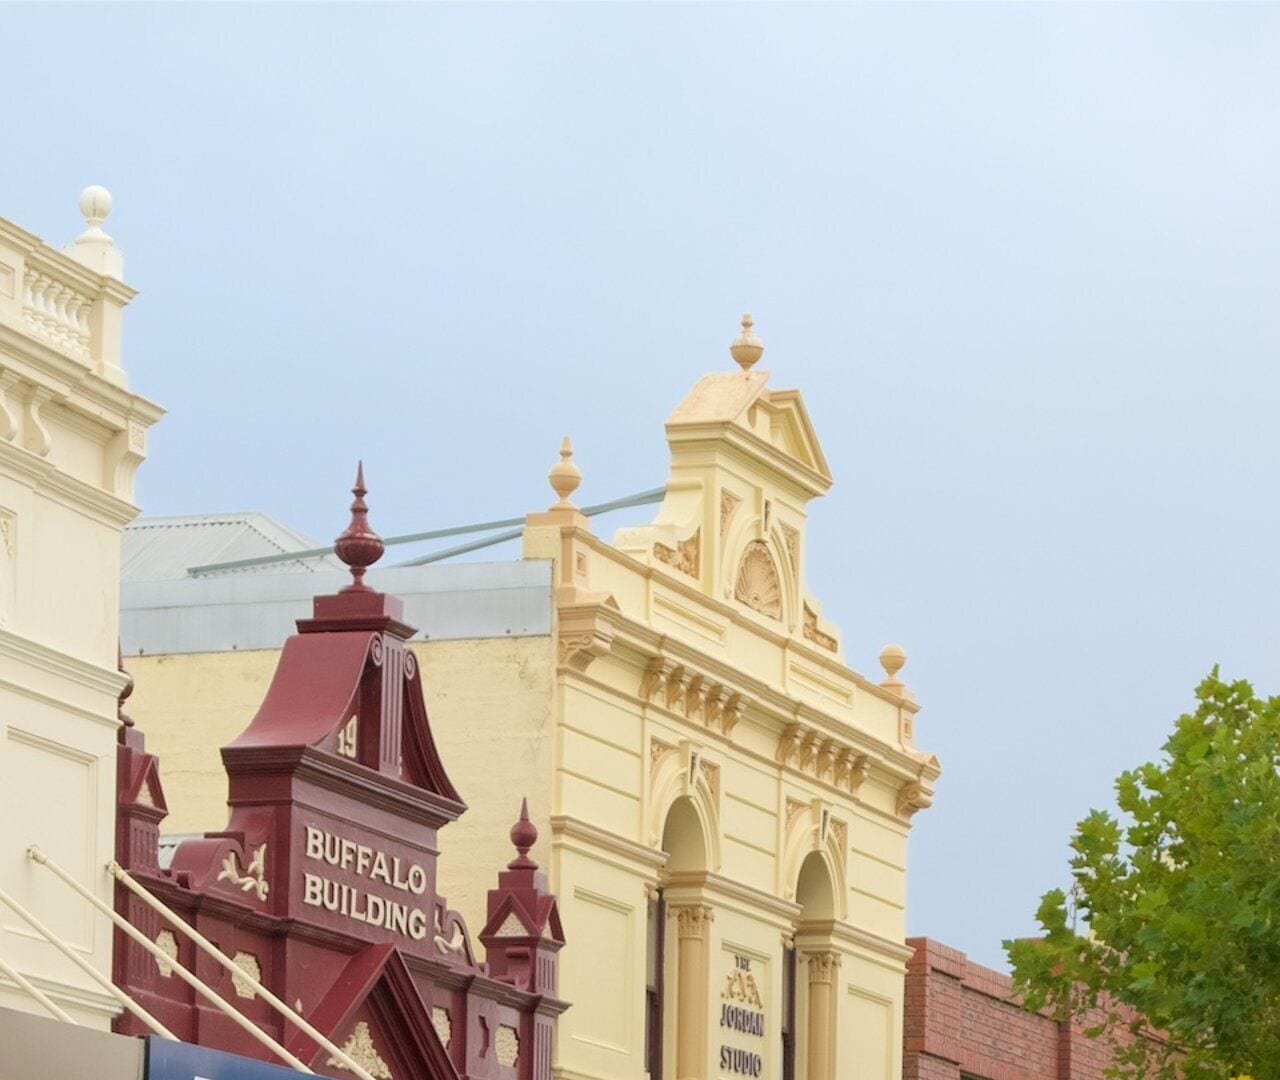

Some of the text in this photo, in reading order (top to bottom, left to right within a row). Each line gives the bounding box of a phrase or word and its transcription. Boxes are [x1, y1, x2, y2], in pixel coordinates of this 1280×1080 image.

[307, 826, 427, 895] BUFFALO
[304, 872, 427, 939] BUILDING
[720, 1003, 764, 1037] JORDAN
[720, 1045, 762, 1078] STUDIO
